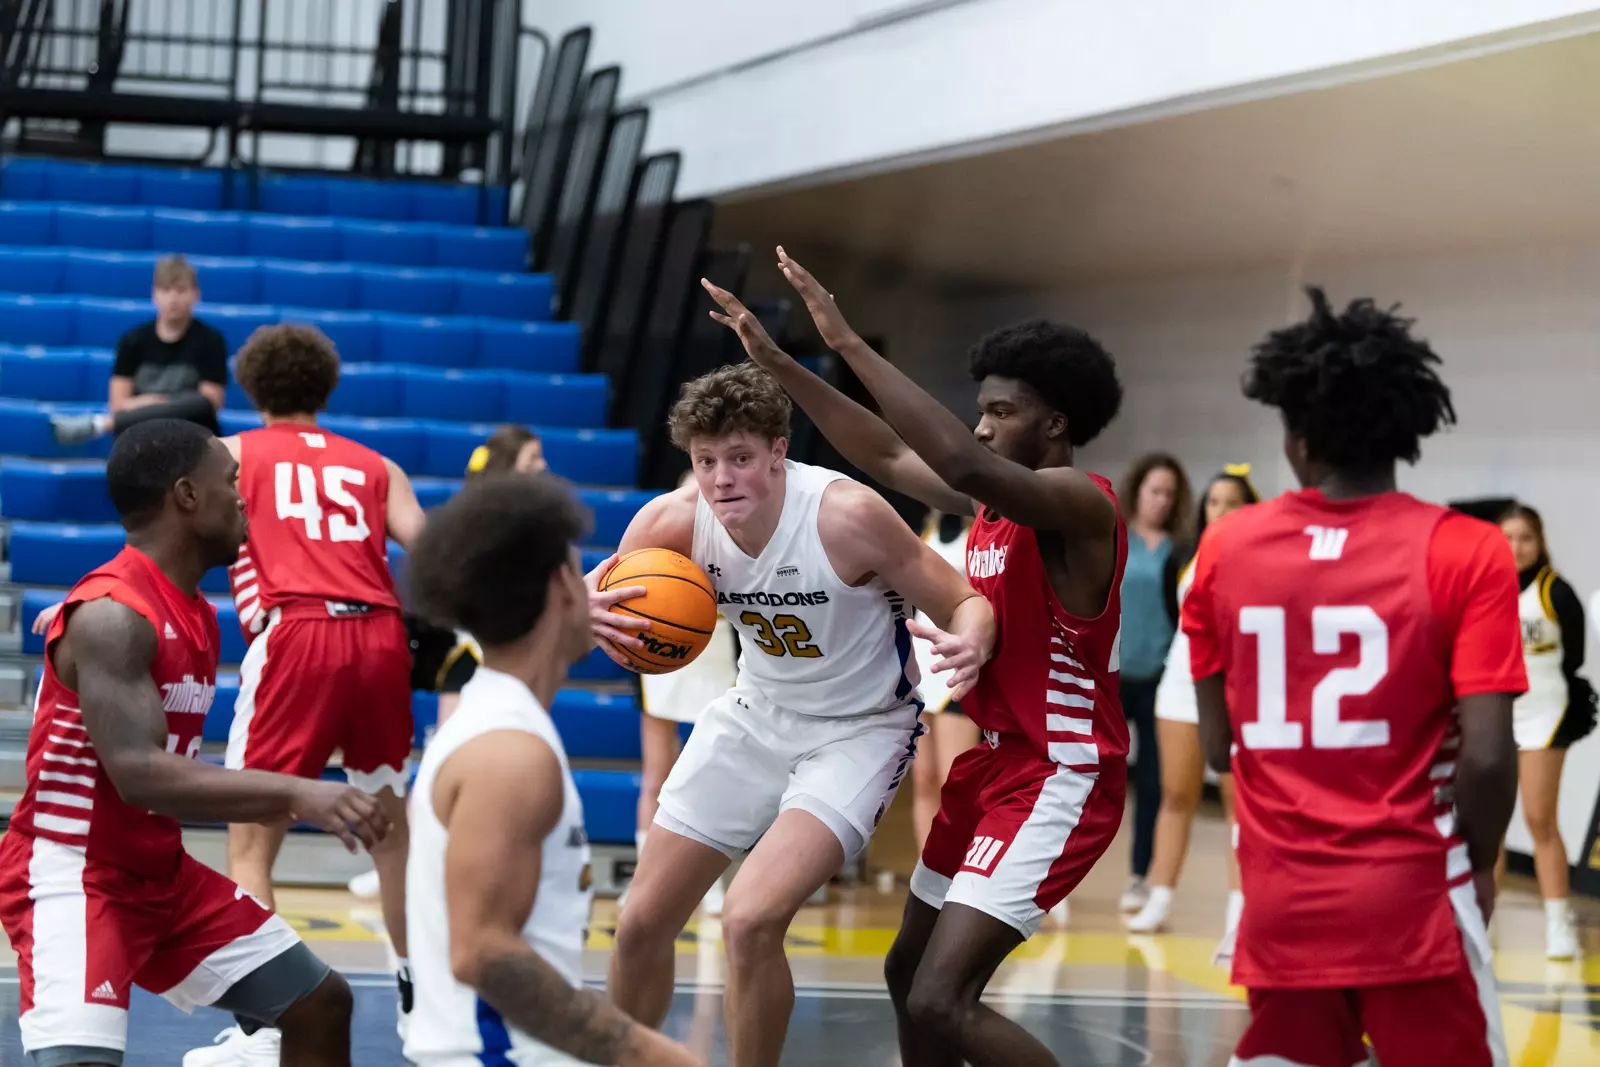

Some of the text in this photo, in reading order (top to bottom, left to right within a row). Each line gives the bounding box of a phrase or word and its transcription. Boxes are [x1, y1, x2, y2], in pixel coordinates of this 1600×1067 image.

[274, 461, 372, 542] 45
[776, 568, 799, 576] HORIZON
[714, 588, 830, 607] ASTODONS
[739, 610, 825, 659] 32
[1239, 605, 1390, 750] 12
